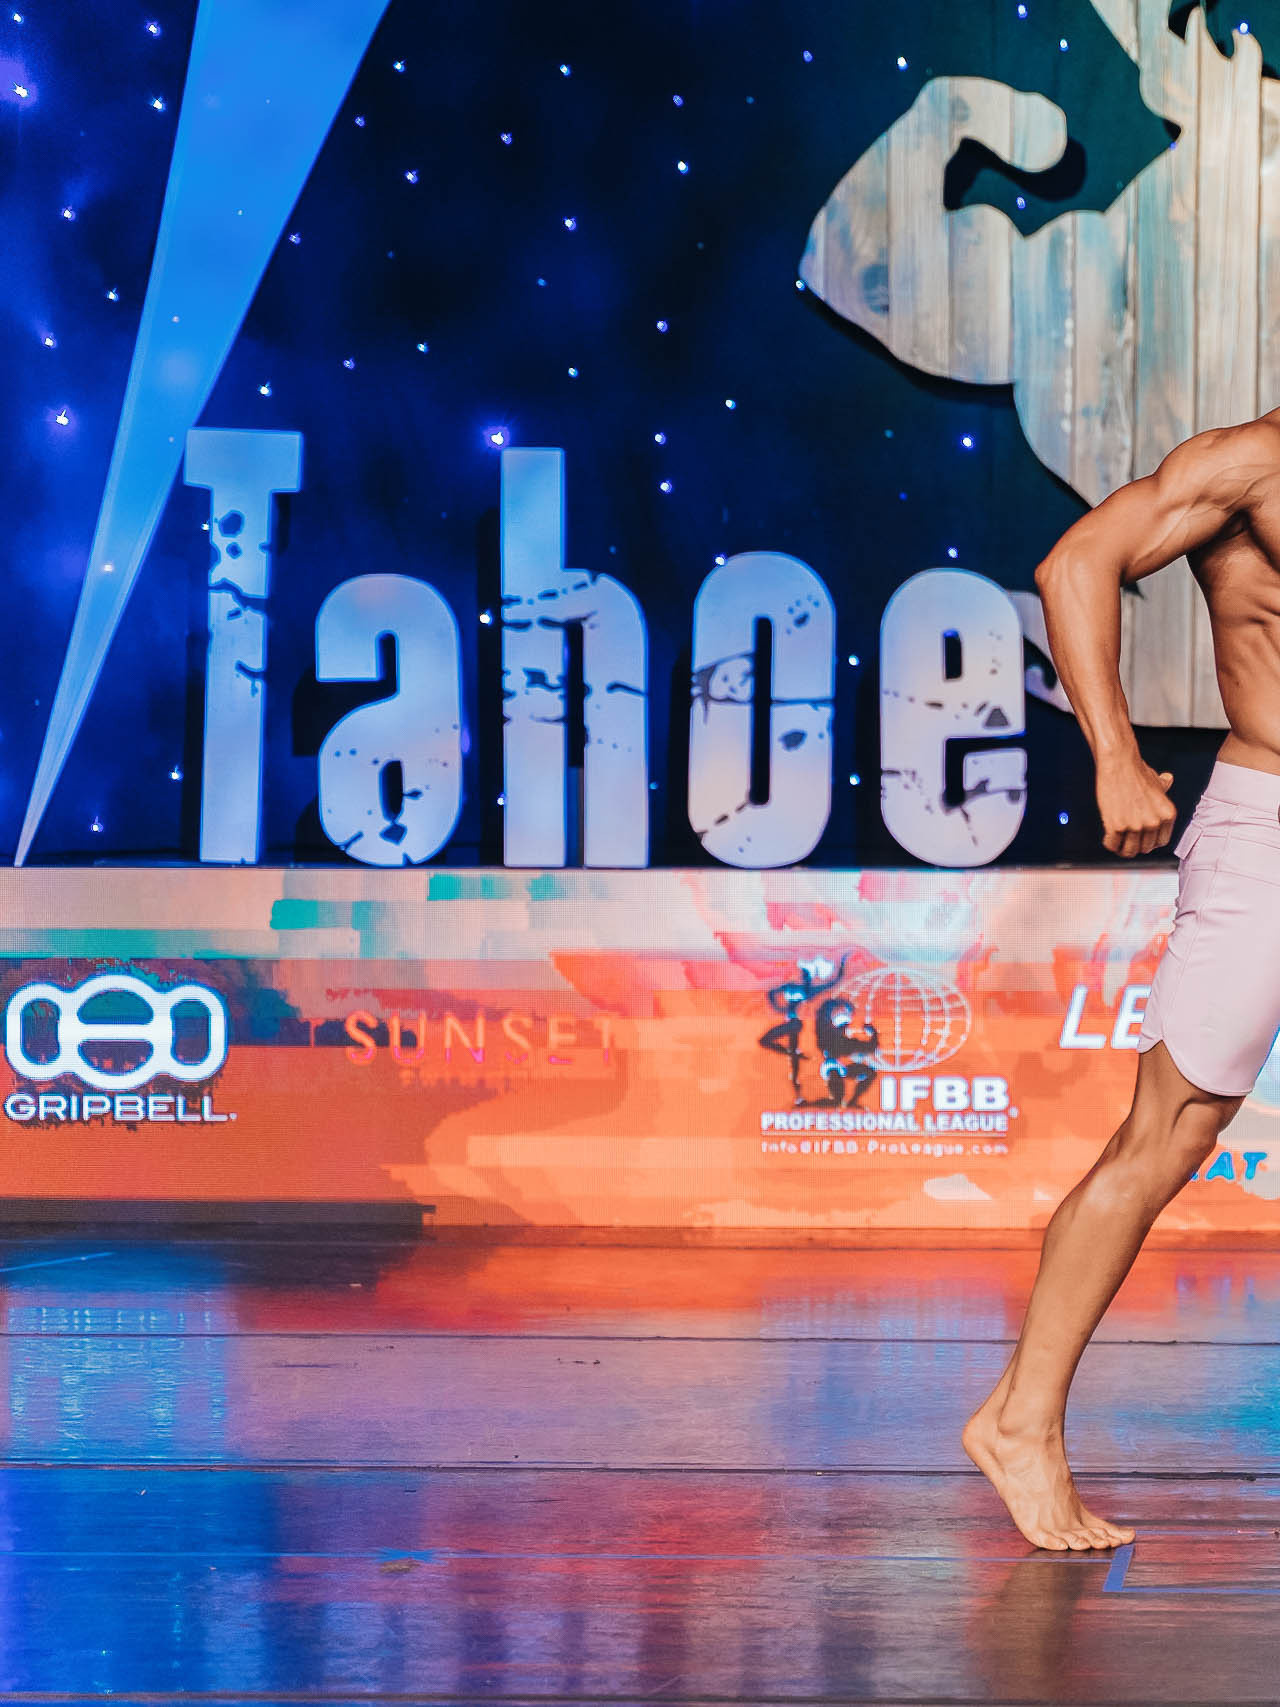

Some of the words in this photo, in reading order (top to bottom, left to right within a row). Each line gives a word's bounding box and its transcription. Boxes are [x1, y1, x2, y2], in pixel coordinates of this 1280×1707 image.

[184, 429, 1027, 869] Tahoe
[344, 1010, 614, 1066] SUNSET
[761, 1112, 921, 1131] PROFESSIONAL
[924, 1112, 1009, 1132] LEAGUE
